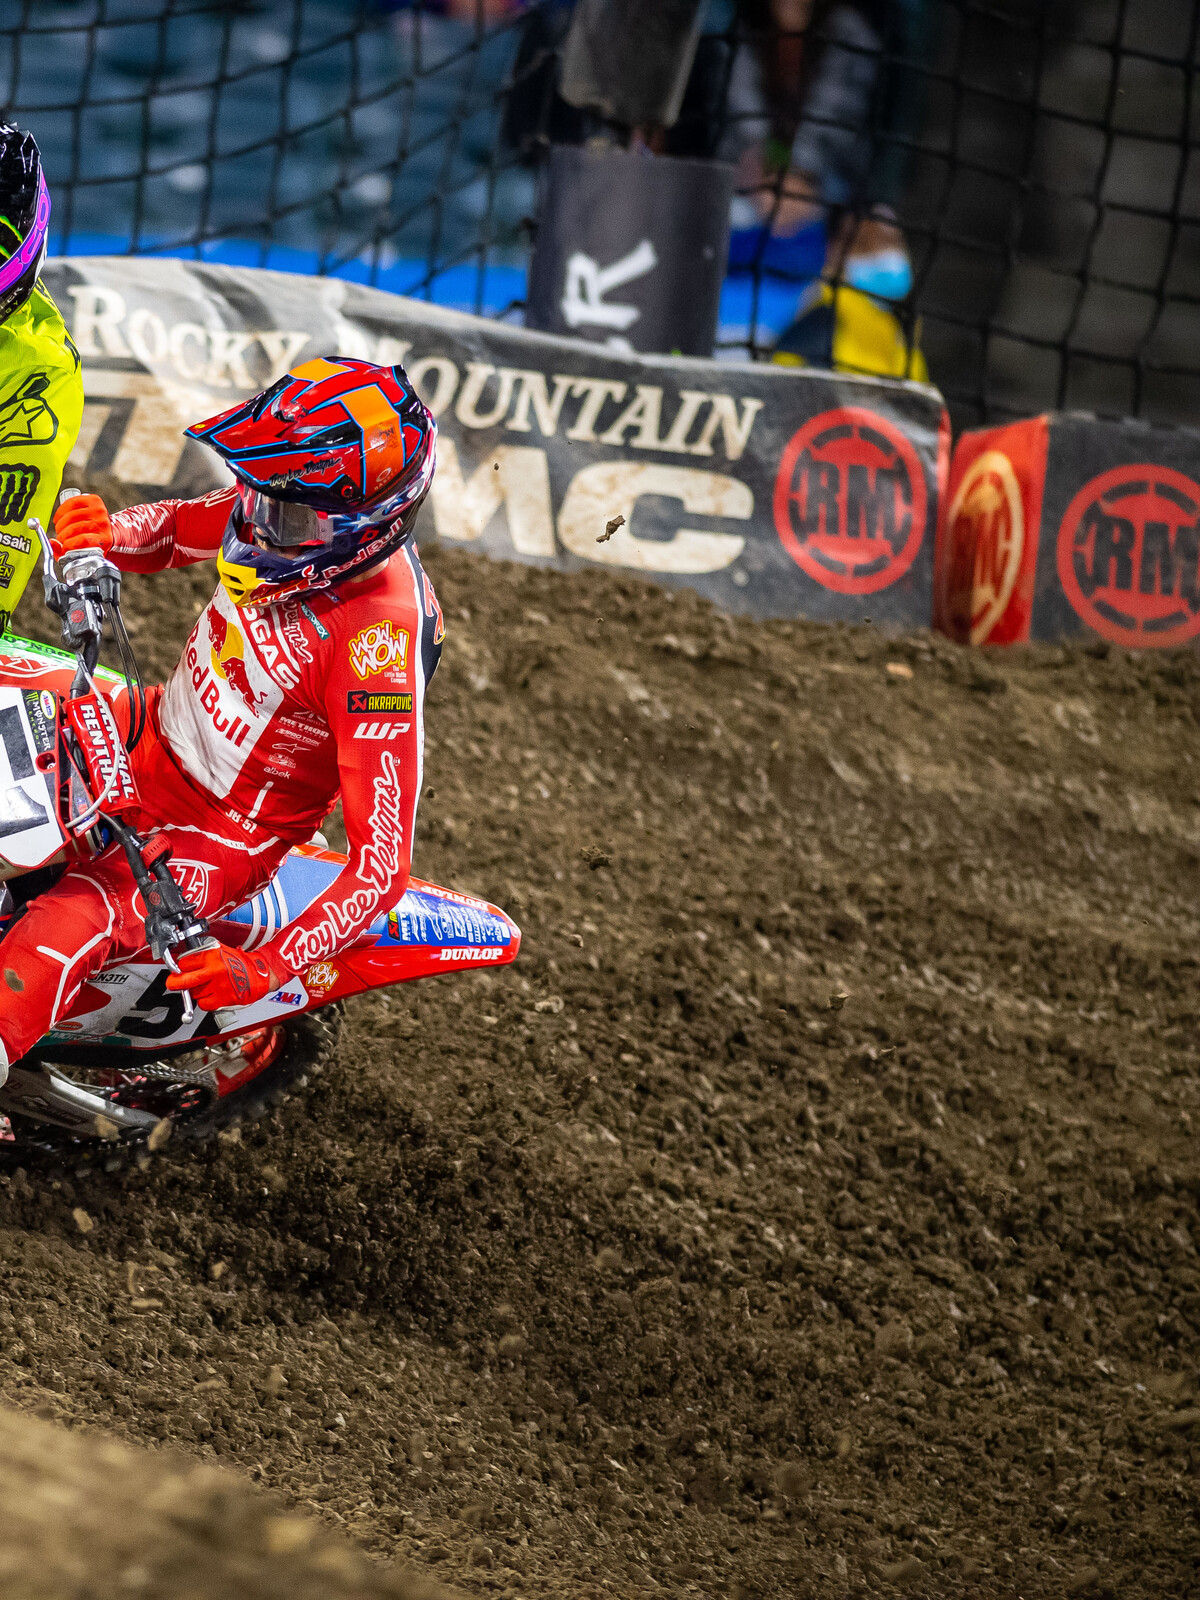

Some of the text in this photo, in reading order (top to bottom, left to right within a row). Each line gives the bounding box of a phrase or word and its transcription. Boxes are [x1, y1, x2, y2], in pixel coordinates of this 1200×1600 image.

[66, 284, 312, 392] ROCKY
[321, 517, 404, 580] Red Bull
[301, 603, 330, 640] MOTOREX
[351, 622, 390, 658] WOW
[243, 605, 300, 690] SGAS
[32, 701, 51, 751] MONSTER
[200, 679, 252, 748] Bull
[279, 716, 329, 740] METHOD
[353, 722, 411, 740] WP
[80, 704, 120, 803] RENTHAL
[279, 750, 404, 970] Troy Lee Designs
[420, 885, 490, 912] DUNLOP
[439, 947, 504, 960] DUNLOP
[268, 991, 302, 1006] AMA
